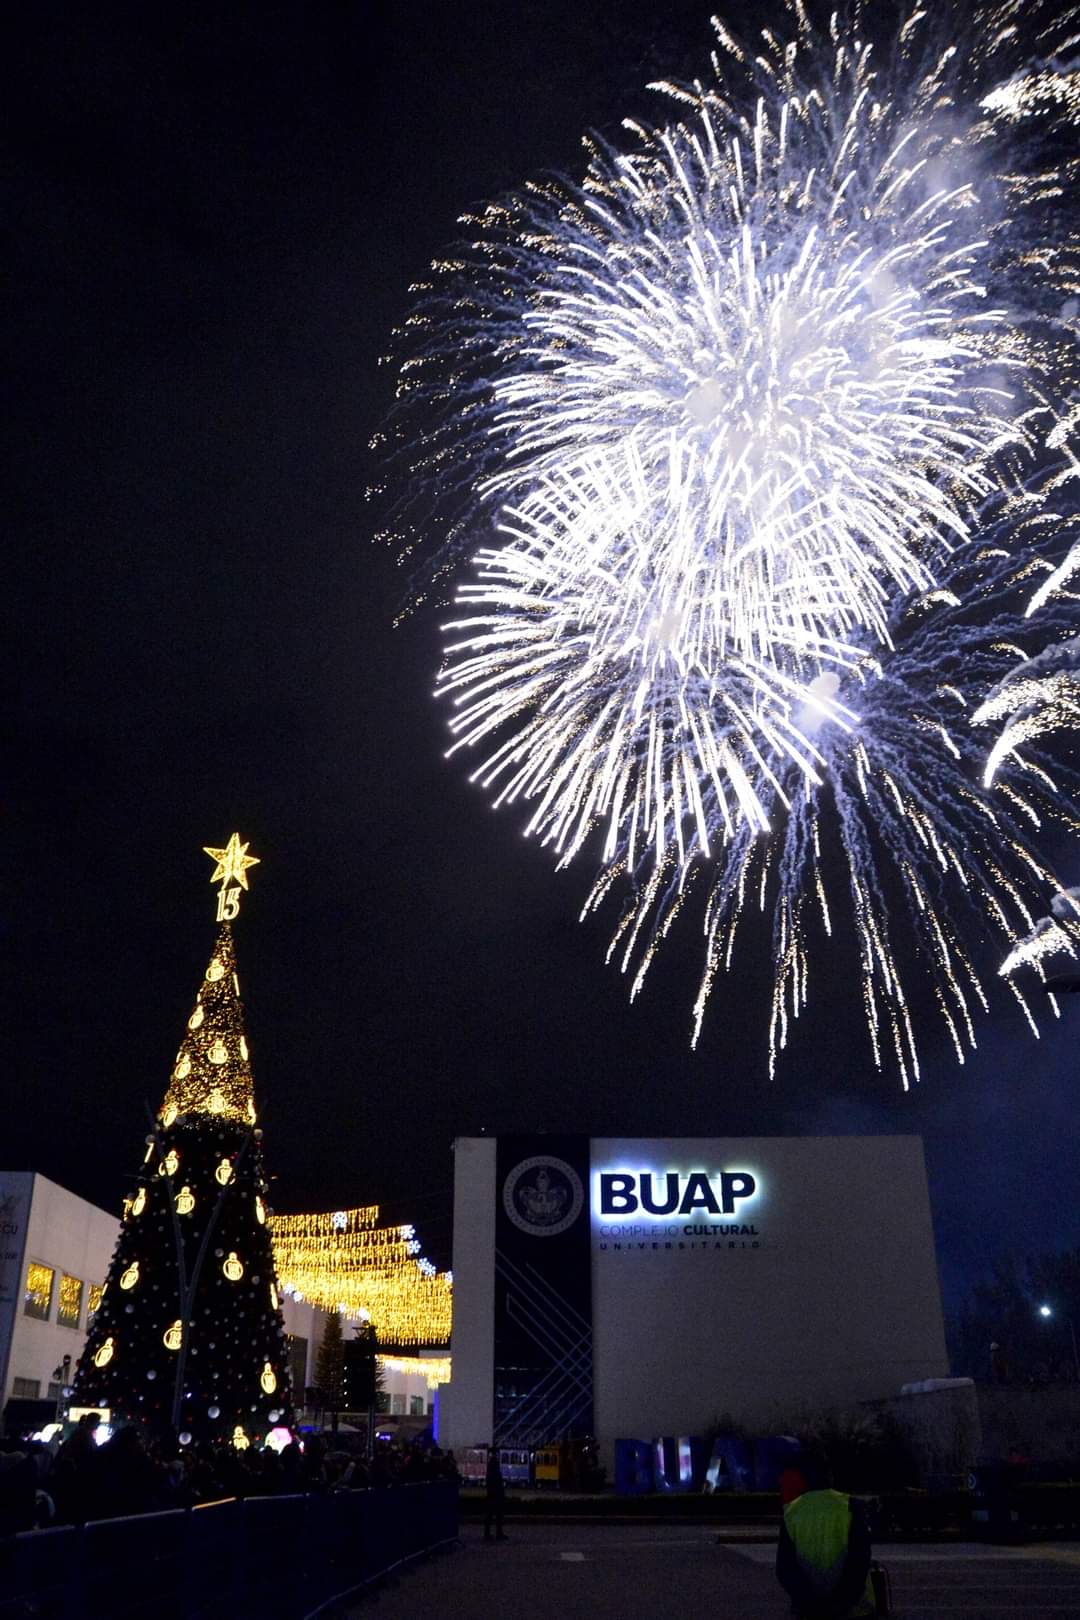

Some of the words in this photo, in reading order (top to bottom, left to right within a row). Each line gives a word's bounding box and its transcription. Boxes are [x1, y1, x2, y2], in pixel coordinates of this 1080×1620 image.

[216, 887, 242, 922] 15
[600, 1172, 756, 1216] BUAP
[600, 1224, 679, 1238] COMPLEJO
[683, 1224, 759, 1236] CULTURAL
[600, 1241, 761, 1251] UNIVERSITARIO
